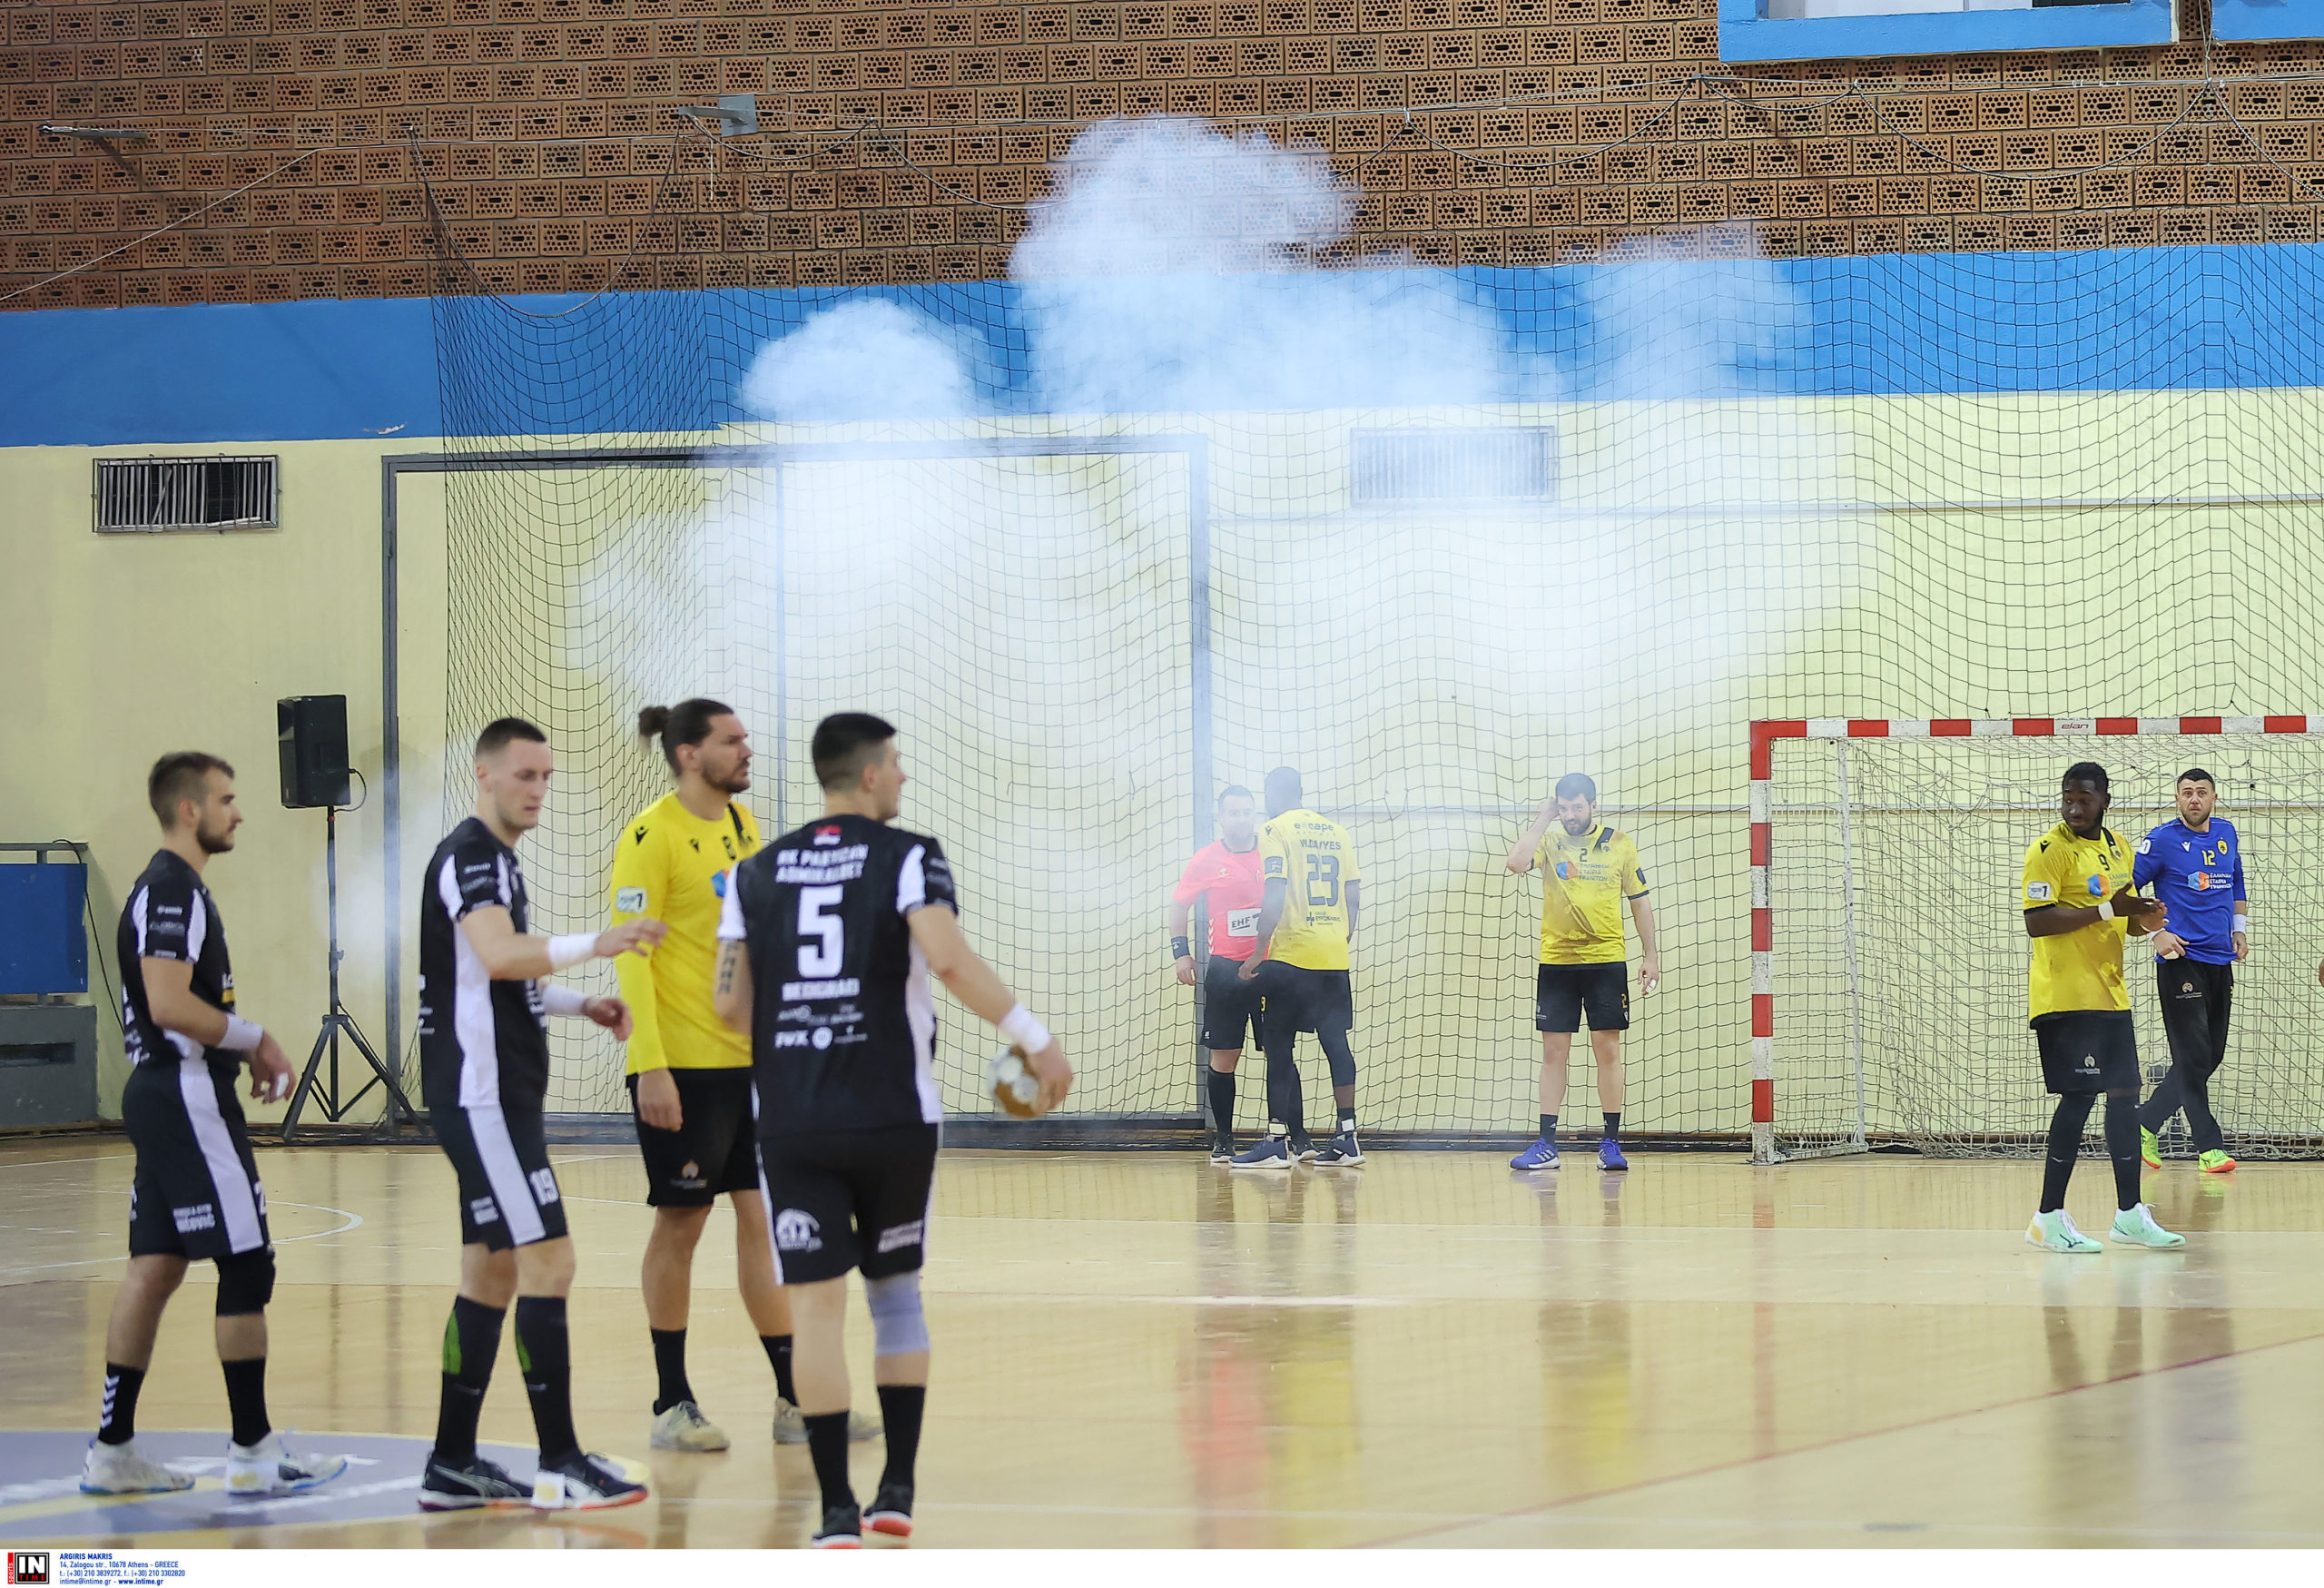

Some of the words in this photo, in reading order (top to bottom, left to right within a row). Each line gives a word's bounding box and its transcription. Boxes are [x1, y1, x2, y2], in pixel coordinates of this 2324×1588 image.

[1580, 848, 1588, 862] 2
[2098, 853, 2110, 871] 9
[2201, 850, 2216, 866] 12
[1306, 854, 1339, 906] 23
[1231, 916, 1251, 928] EHF
[797, 883, 844, 979] 5
